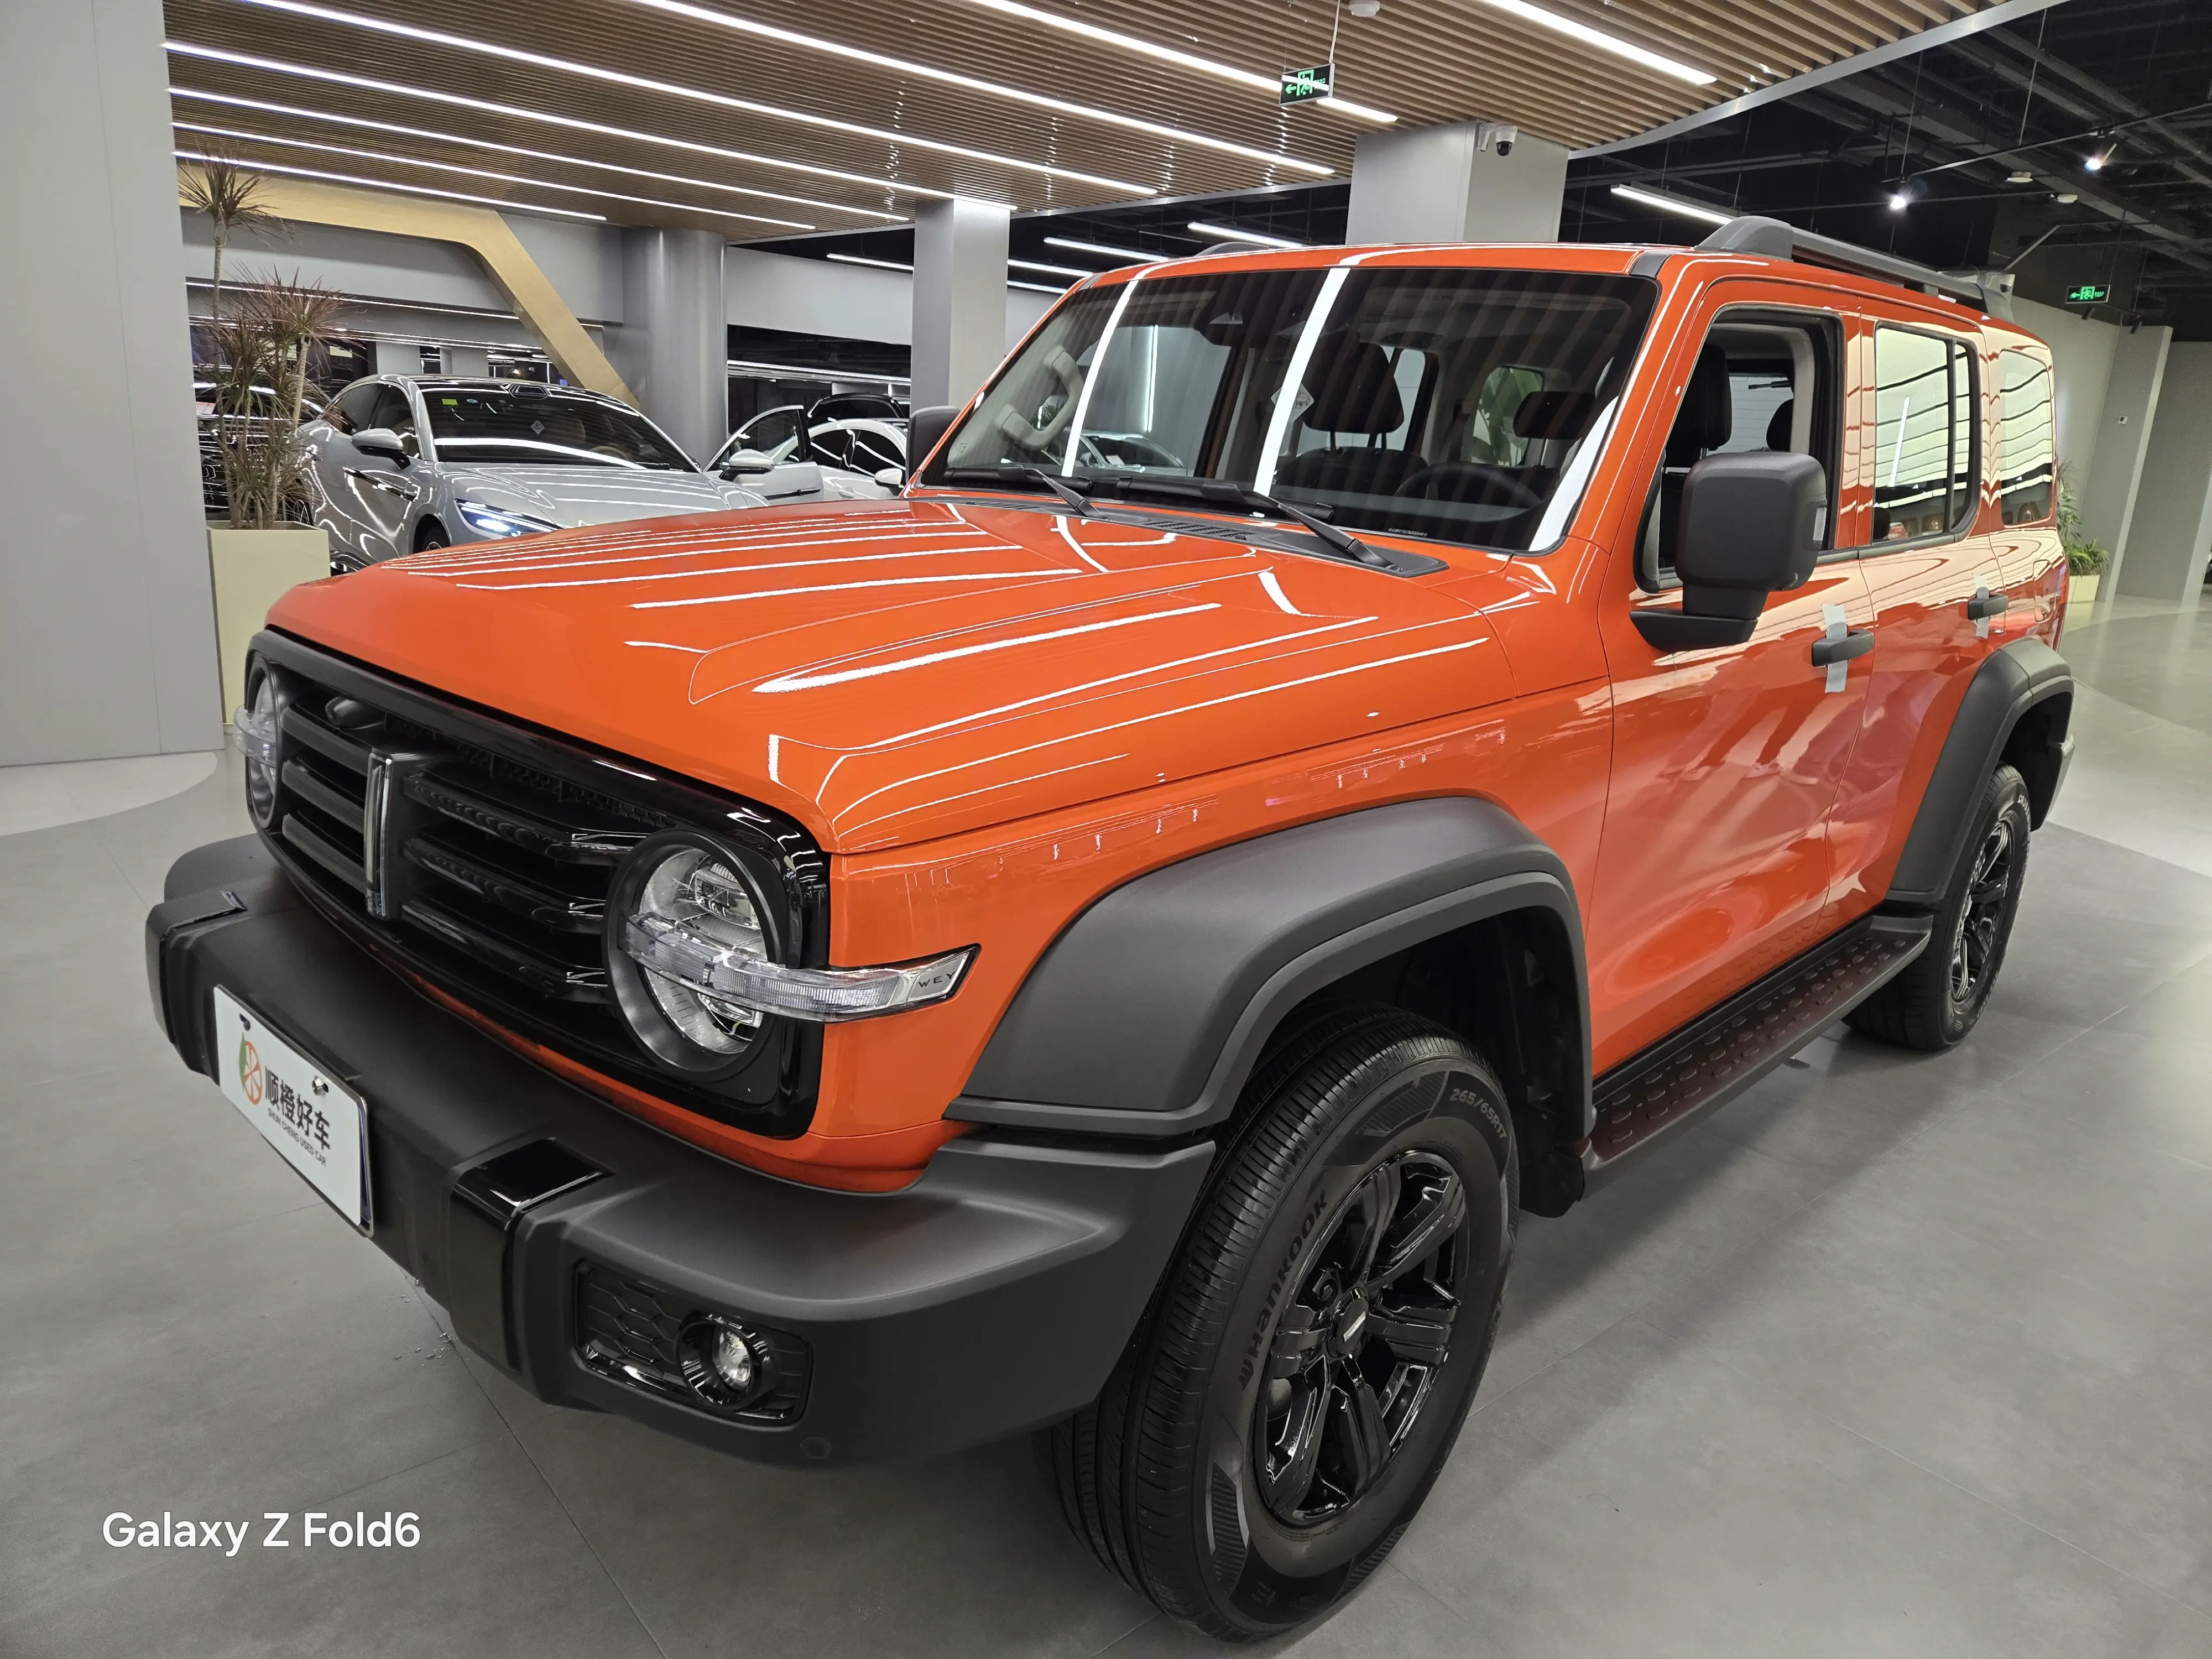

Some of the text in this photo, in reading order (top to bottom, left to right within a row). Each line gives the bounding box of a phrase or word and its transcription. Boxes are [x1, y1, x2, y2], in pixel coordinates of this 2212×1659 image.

[918, 972, 955, 988] WEY
[265, 1066, 330, 1151] 顺橙好车
[1449, 1088, 1506, 1139] 265/65R17
[268, 1108, 326, 1167] SHUN CHENG USED CAR
